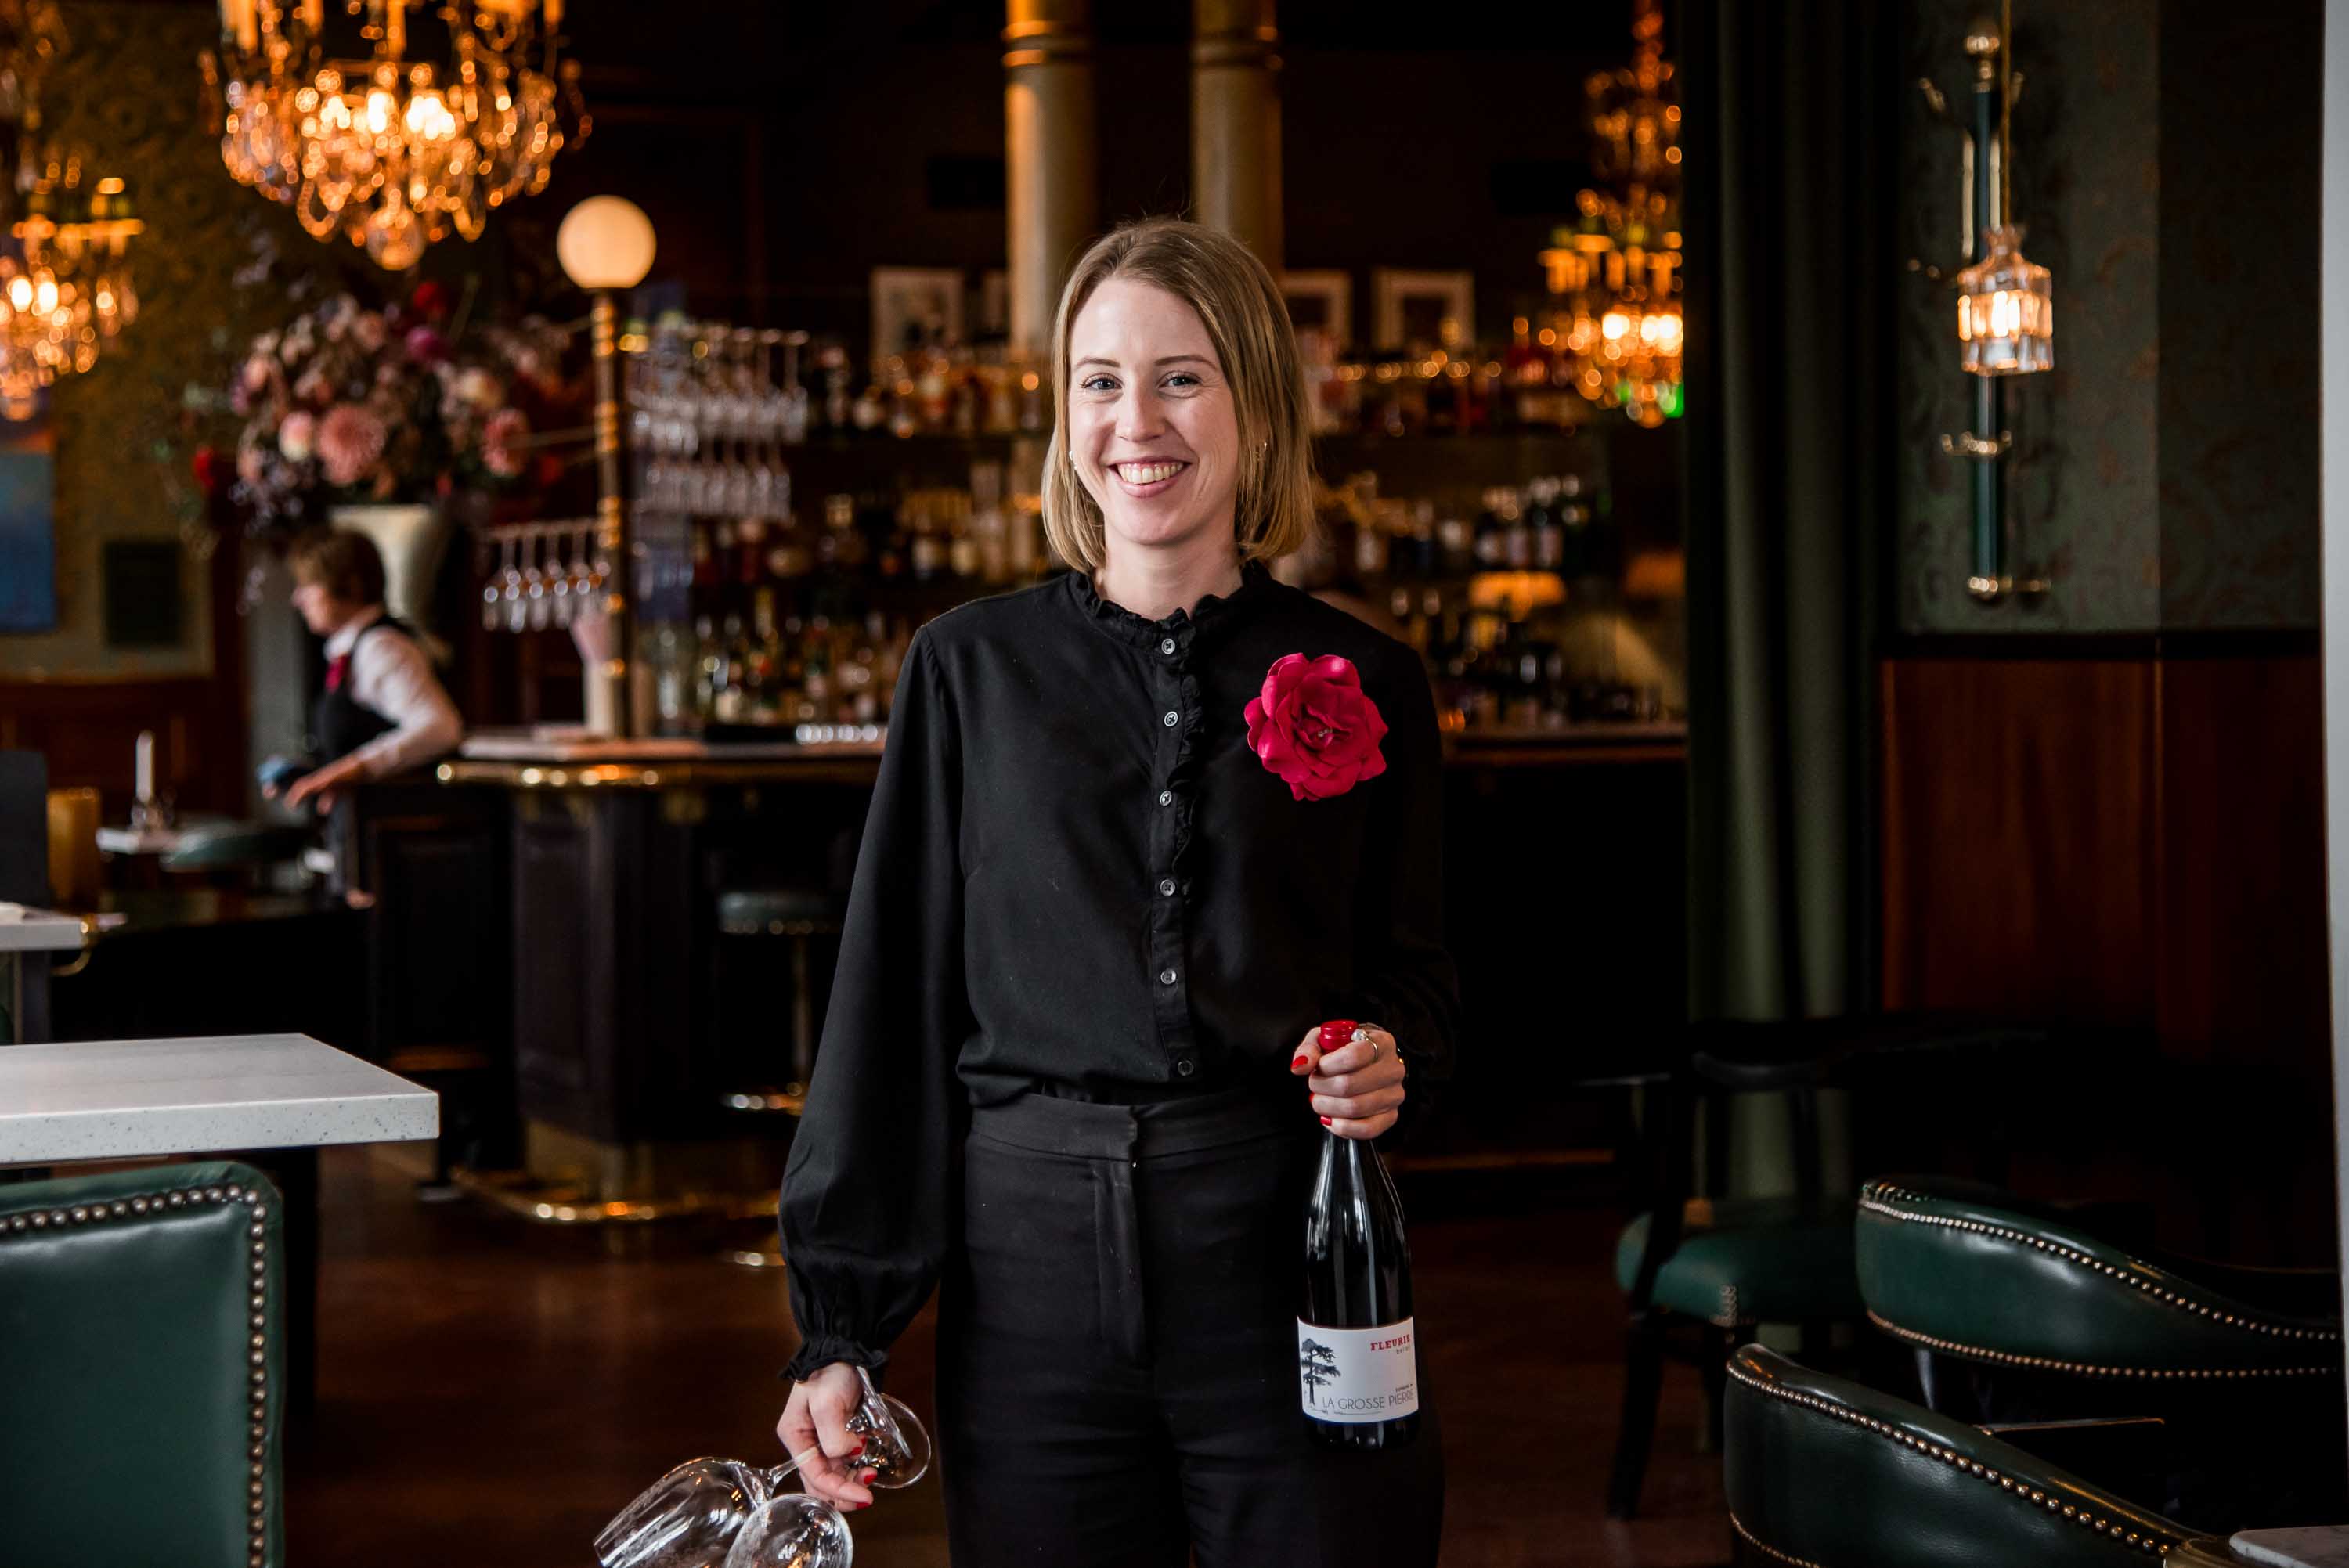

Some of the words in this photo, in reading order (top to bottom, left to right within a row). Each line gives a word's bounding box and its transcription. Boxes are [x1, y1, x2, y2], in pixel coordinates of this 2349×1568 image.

[1370, 1334, 1410, 1351] FLEURIE
[1322, 1397, 1335, 1408] LA
[1337, 1397, 1385, 1410] GROSSE
